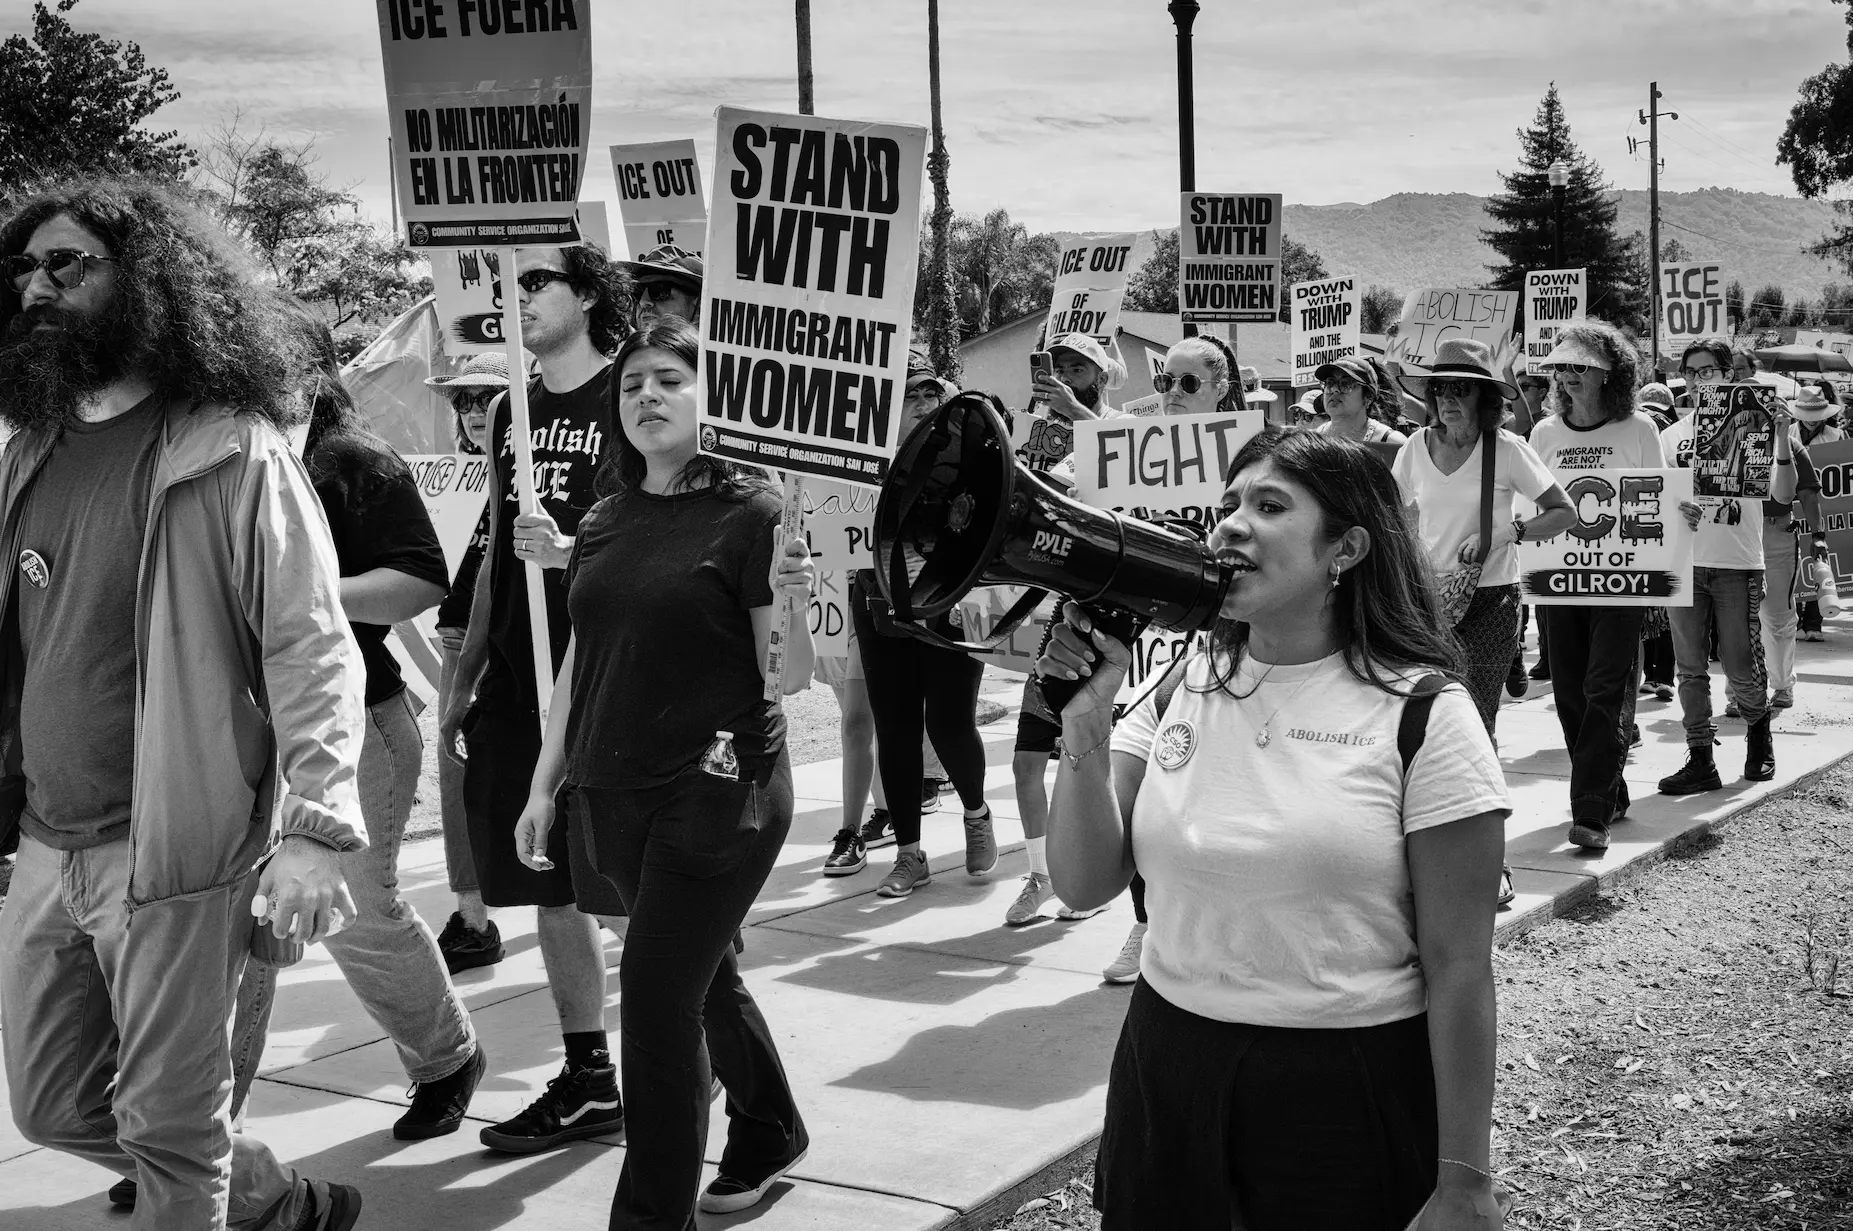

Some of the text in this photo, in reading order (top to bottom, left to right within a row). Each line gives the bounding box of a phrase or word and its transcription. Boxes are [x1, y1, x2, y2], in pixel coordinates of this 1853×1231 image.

[388, 0, 578, 41] ICE FUERA
[405, 91, 580, 153] NO MILITARIZACIÓN
[617, 158, 696, 200] ICE OUT
[731, 123, 900, 215] STAND
[410, 158, 440, 206] EN
[443, 157, 475, 205] LA
[1190, 197, 1272, 225] STAND
[431, 226, 477, 238] COMMUNITY
[478, 226, 506, 236] SERVICE
[507, 223, 559, 236] ORGANIZATION
[1195, 226, 1266, 255] WITH
[736, 203, 890, 299] WITH
[1060, 246, 1131, 277] ICE OUT
[1185, 264, 1274, 281] IMMIGRANT
[1530, 273, 1579, 286] DOWN
[1664, 266, 1719, 299] ICE
[1184, 284, 1274, 309] WOMEN
[1296, 280, 1353, 299] DOWN
[1307, 294, 1342, 306] WITH
[1539, 286, 1569, 296] WITH
[1071, 293, 1089, 310] OF
[1413, 291, 1509, 323] ABOLISH
[1533, 296, 1578, 320] TRUMP
[1050, 310, 1107, 337] GILROY
[1301, 302, 1352, 331] TRUMP
[1667, 299, 1723, 335] OUT
[709, 298, 897, 368] IMMIGRANT
[1310, 333, 1341, 349] AND THE
[1540, 327, 1552, 340] AND
[705, 350, 894, 447] WOMEN
[1700, 385, 1719, 393] CAST
[1703, 392, 1727, 400] DOWN
[1698, 407, 1727, 415] MIGHTY
[1740, 440, 1755, 449] THE
[1746, 433, 1769, 441] SEND
[719, 434, 879, 475] COMMUNITY SERVICE ORGANIZATION SAN JOSÉ
[1097, 419, 1238, 489] FIGHT
[1556, 446, 1613, 458] IMMIGRANTS
[1561, 455, 1601, 465] ARE NOT
[1745, 449, 1764, 457] RICH
[1745, 456, 1773, 465] AWAY
[1032, 530, 1073, 557] PYLE
[1563, 551, 1635, 567] OUT OF
[1548, 573, 1650, 594] GILROY!
[1285, 728, 1377, 746] ABOLISH ICE
